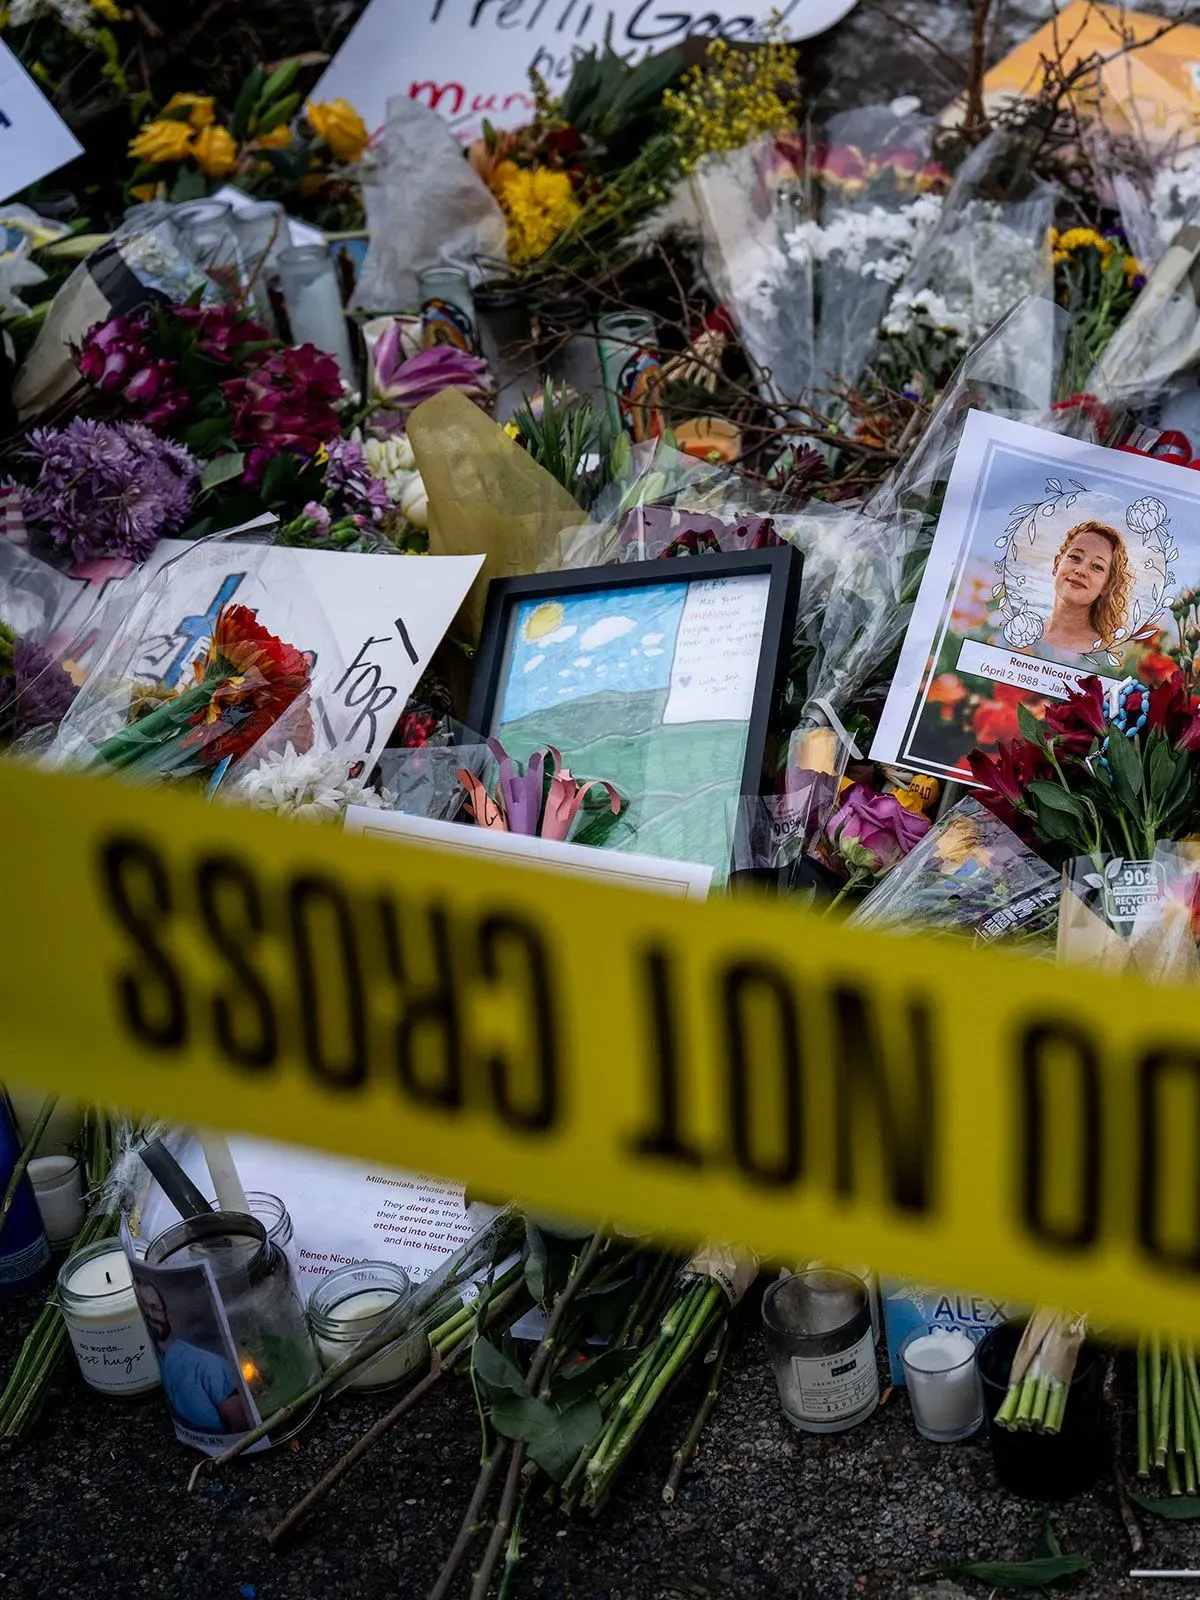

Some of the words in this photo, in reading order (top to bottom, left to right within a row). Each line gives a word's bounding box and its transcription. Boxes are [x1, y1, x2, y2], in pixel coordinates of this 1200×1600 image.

[980, 662, 1006, 678] (April
[1017, 673, 1039, 687] 1988
[1009, 656, 1040, 673] Renee
[1041, 665, 1072, 681] Nicole
[333, 635, 398, 754] FOR
[1123, 869, 1158, 886] 90%
[1115, 895, 1158, 906] RECYCLED
[92, 828, 568, 1138] CROSS
[623, 915, 940, 1222] NOT
[366, 1175, 415, 1190] Millennials
[416, 1184, 445, 1195] whose
[446, 1190, 464, 1198] ans
[383, 1199, 405, 1211] They
[406, 1203, 428, 1213] died
[429, 1208, 440, 1216] as
[442, 1208, 464, 1220] they
[418, 1195, 436, 1204] was
[376, 1210, 398, 1220] their
[398, 1213, 433, 1226] service
[434, 1218, 453, 1229] and
[373, 1221, 407, 1233] etched
[408, 1226, 427, 1237] into
[428, 1231, 447, 1241] our
[447, 1232, 469, 1244] hear
[383, 1235, 402, 1246] and
[403, 1238, 422, 1249] into
[299, 1249, 328, 1261] Renee
[423, 1268, 434, 1277] 19
[308, 1265, 335, 1276] Jeffre
[934, 1295, 1010, 1322] ALEX
[103, 1352, 145, 1374] hugs
